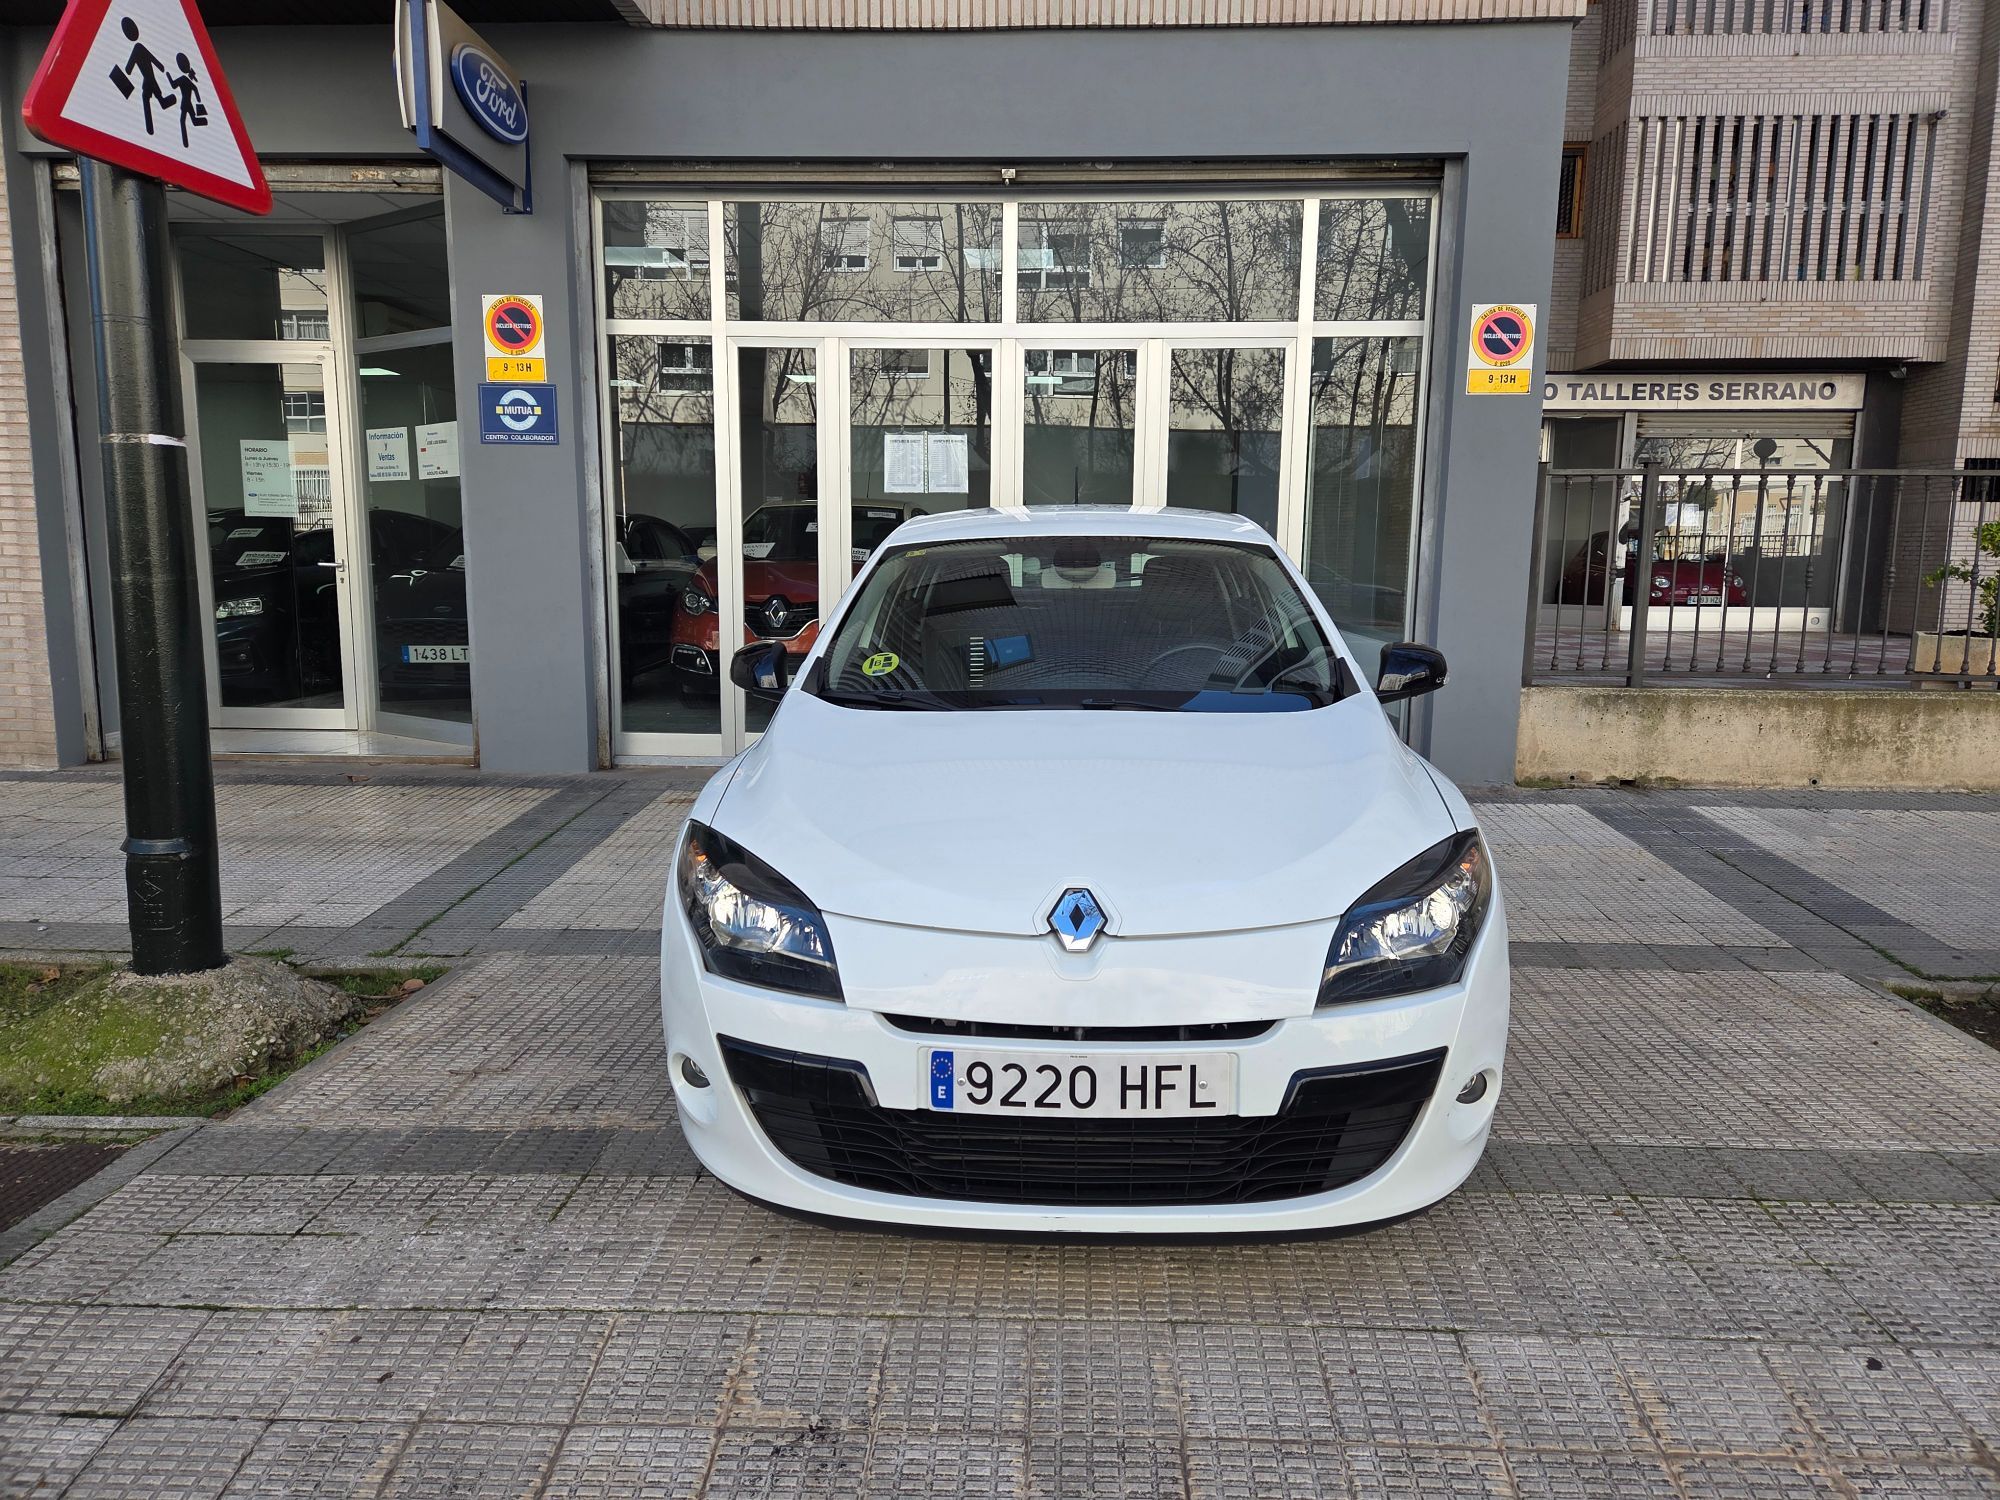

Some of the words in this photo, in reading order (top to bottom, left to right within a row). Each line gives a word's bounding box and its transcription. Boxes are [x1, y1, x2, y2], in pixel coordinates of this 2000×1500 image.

[476, 62, 517, 129] Ford
[492, 298, 505, 310] SALIDA
[1481, 308, 1496, 320] SALIDA
[1506, 306, 1527, 320] VEHICULOS
[1566, 382, 1700, 401] TALLERES
[1708, 382, 1837, 400] SERRANO
[504, 406, 533, 415] MUTUA
[369, 432, 403, 440] Información
[384, 442, 388, 451] y
[378, 453, 395, 461] Ventas
[414, 648, 447, 660] 1438
[452, 648, 468, 660] LT
[938, 1086, 946, 1099] E
[966, 1061, 1097, 1110] 9220
[1120, 1064, 1217, 1110] HFL
